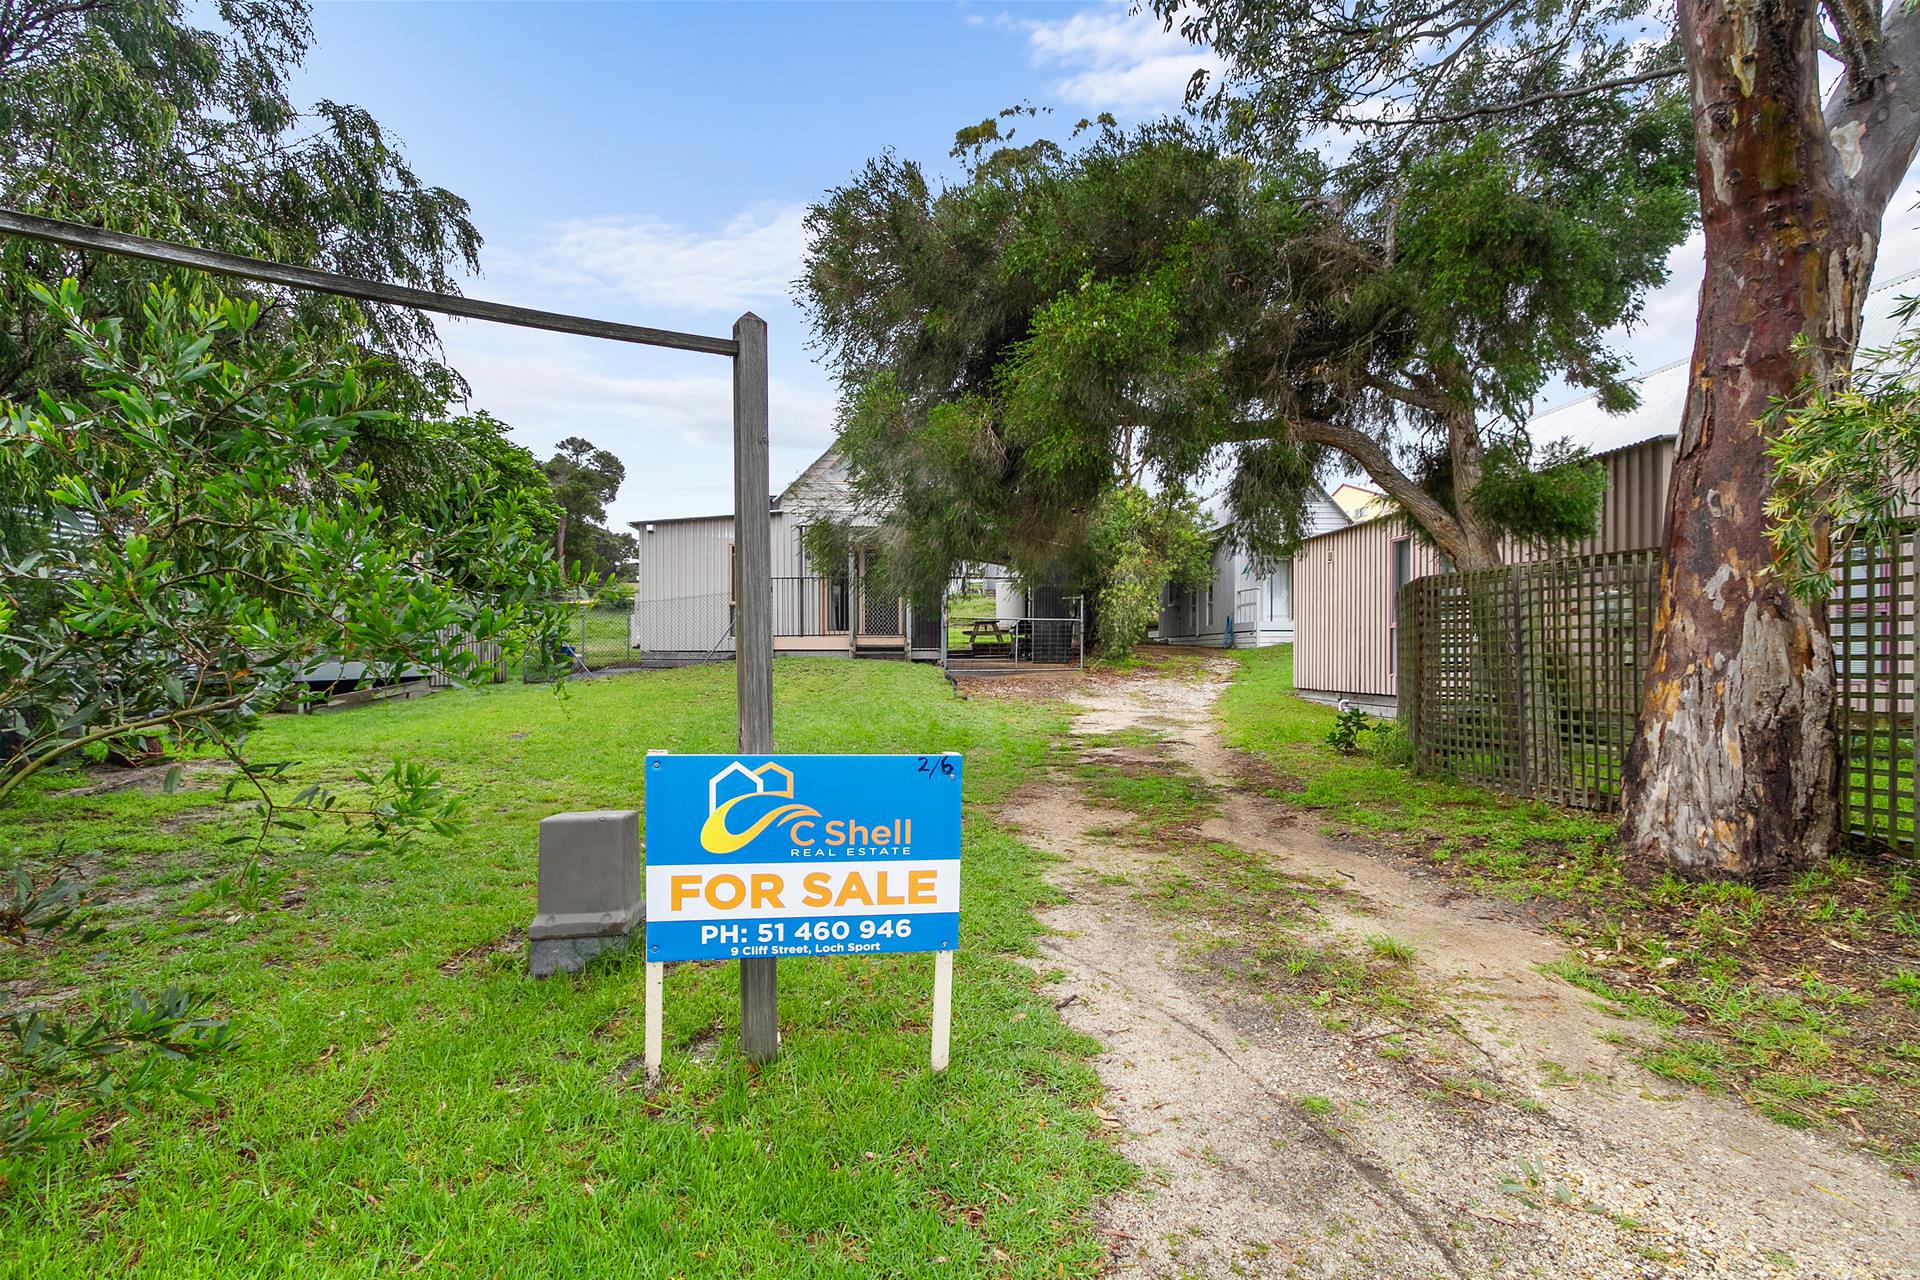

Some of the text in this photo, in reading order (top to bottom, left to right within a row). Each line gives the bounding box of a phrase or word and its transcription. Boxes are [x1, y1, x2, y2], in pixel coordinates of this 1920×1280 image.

[917, 756, 954, 779] 2/6
[790, 818, 912, 847] C Shell
[790, 846, 912, 857] REAL ESTATE
[670, 870, 938, 911] FOR SALE
[701, 918, 912, 944] PH: 51 460 946
[730, 941, 881, 956] 9 Cliff Street, Loch Sport
